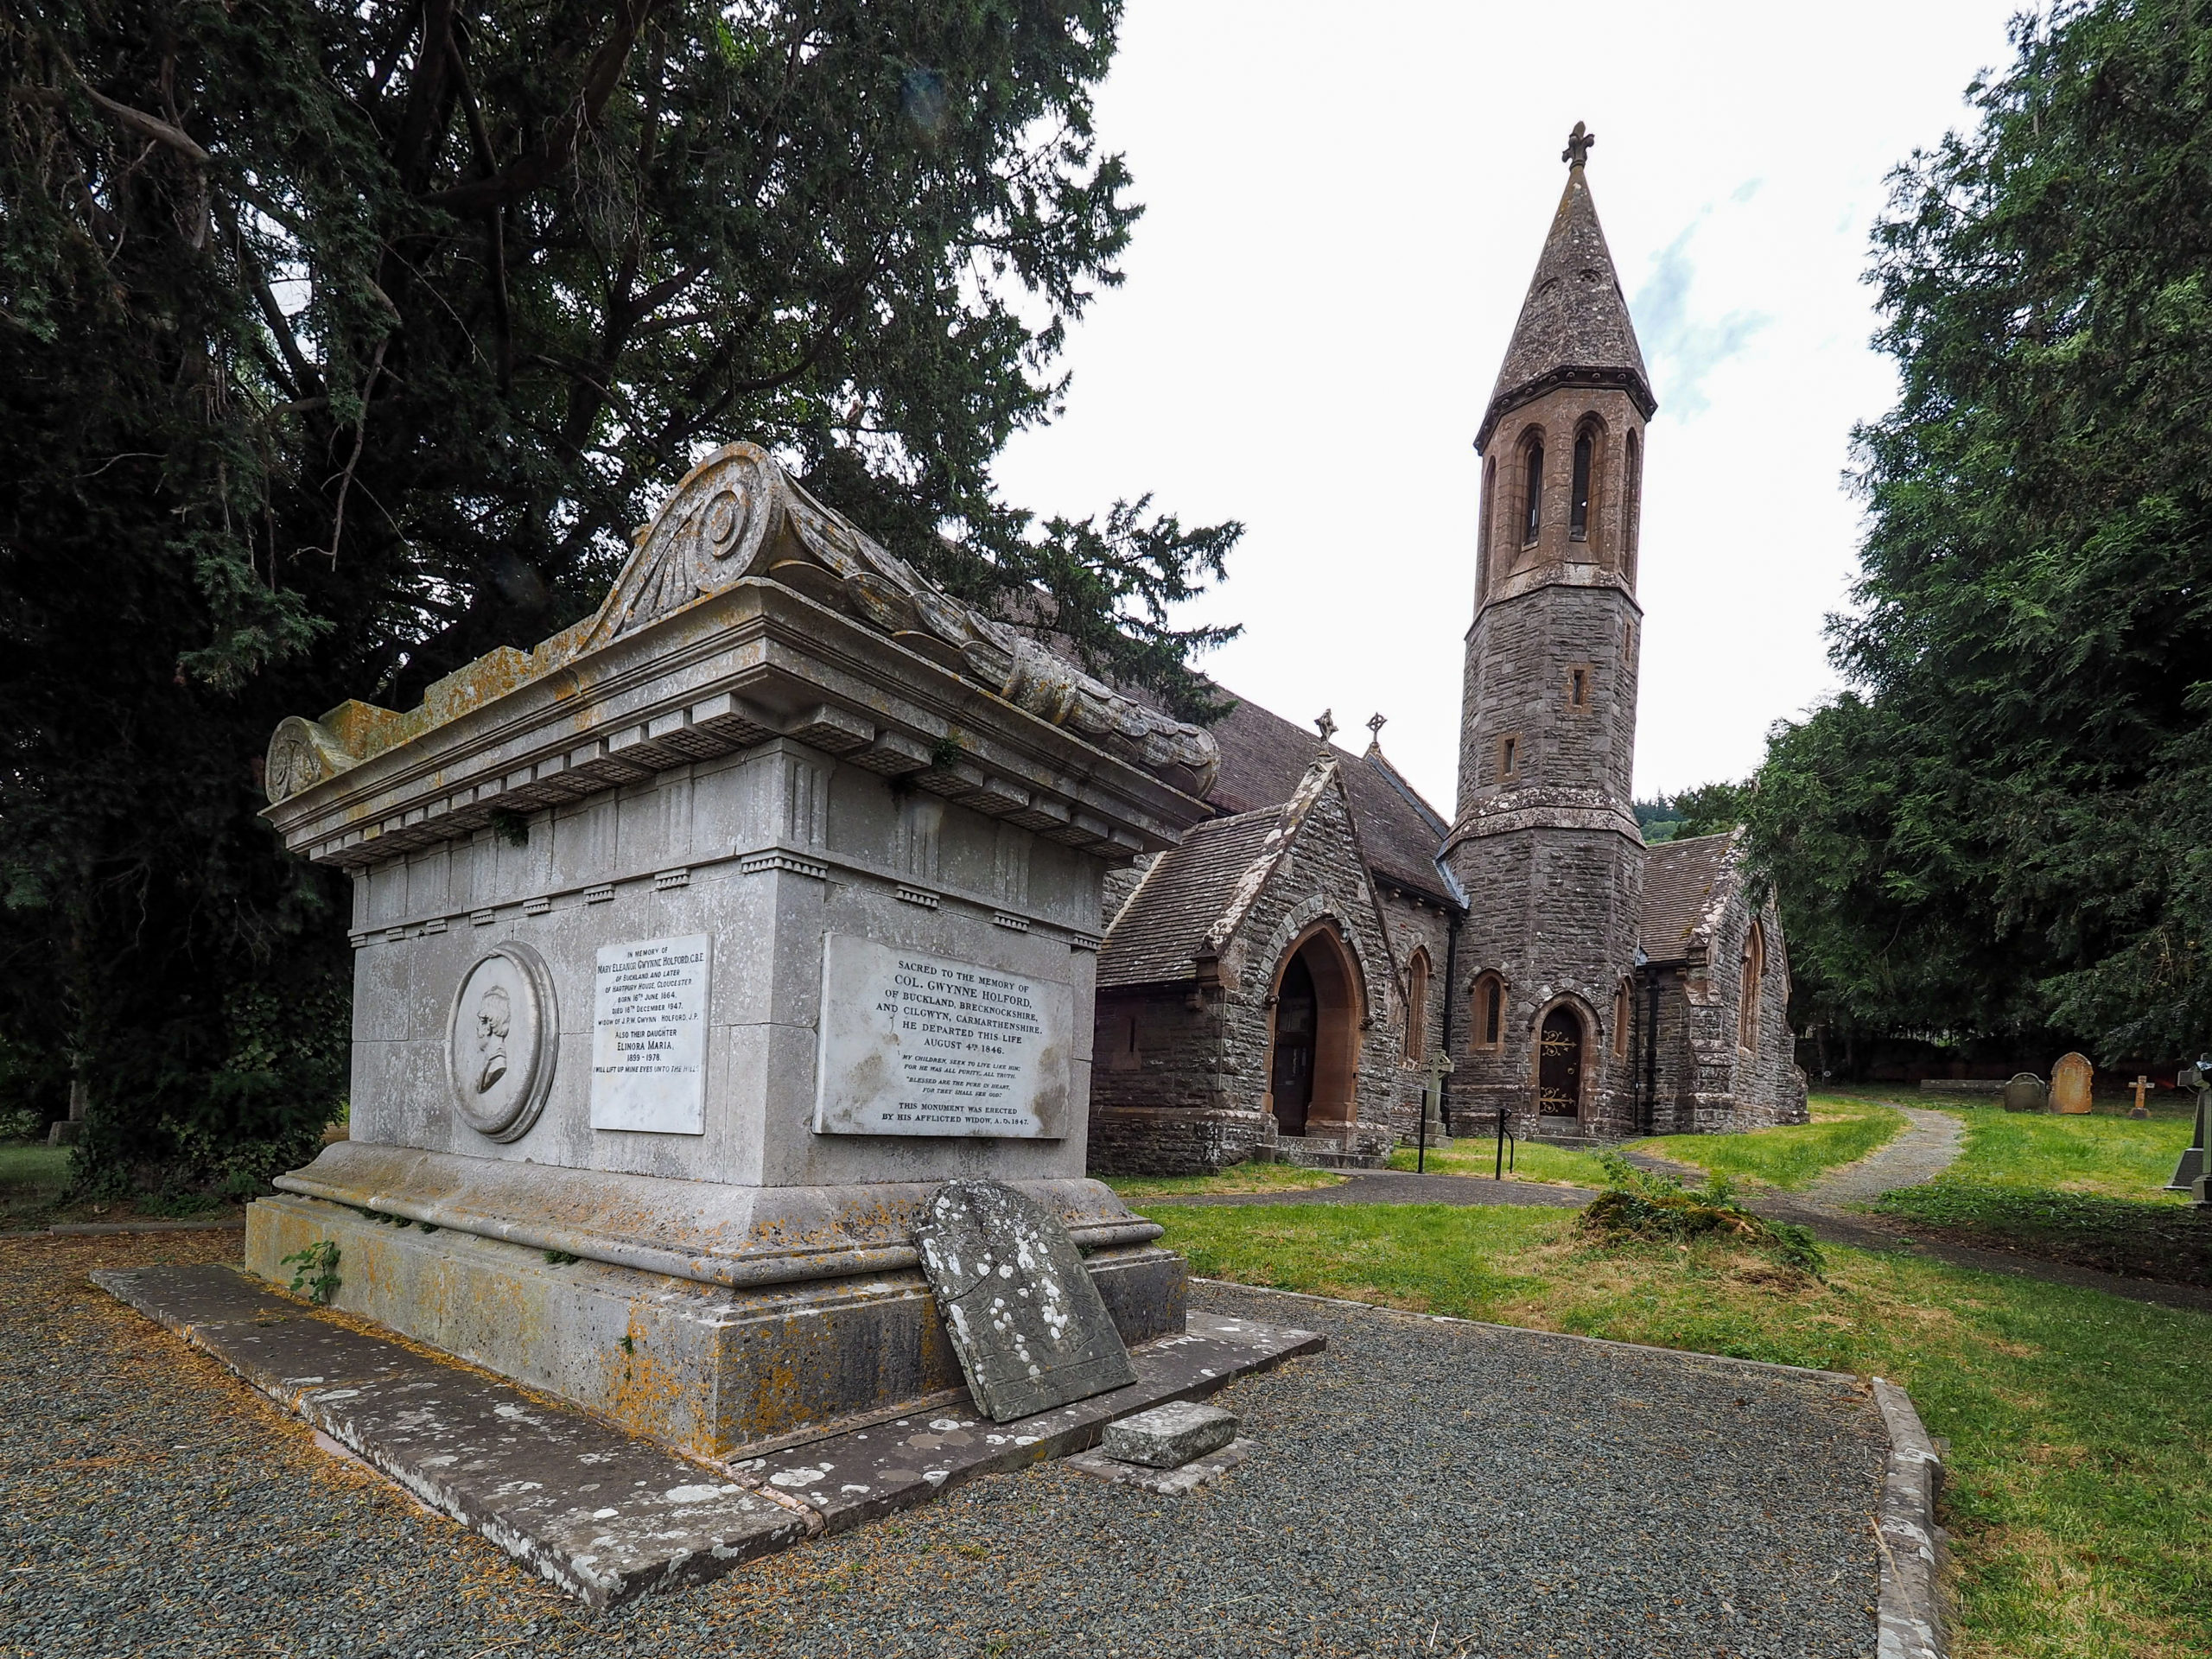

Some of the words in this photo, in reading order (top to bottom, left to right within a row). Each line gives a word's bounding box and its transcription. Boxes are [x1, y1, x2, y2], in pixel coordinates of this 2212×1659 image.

[635, 948, 659, 957] MEMORY
[597, 965, 612, 974] MARY
[613, 962, 637, 972] ELEANOR
[638, 958, 662, 969] GWYNNE
[663, 969, 681, 977] LATER
[898, 960, 938, 975] SACRED
[941, 969, 953, 978] TO
[957, 971, 975, 982] THE
[978, 976, 1015, 990] MEMORY
[1018, 984, 1029, 993] OF
[613, 984, 637, 993] HARTPURY
[894, 975, 924, 988] COL.
[927, 980, 977, 998] GWYNNE
[982, 990, 1032, 1009] HOLFORD,
[636, 1004, 665, 1013] DECEMBER
[885, 989, 899, 998] OF
[903, 992, 957, 1008] BUCKLAND,
[959, 1001, 1038, 1022] BRECKNOCKSHIRE,
[876, 1002, 899, 1013] AND
[903, 1007, 952, 1022] CILGWYN,
[956, 1014, 1042, 1034] CARMARTHENSHIRE.
[646, 1029, 677, 1038] DAUGHTER
[902, 1020, 917, 1030] HE
[922, 1023, 974, 1038] DEPARTED
[978, 1031, 999, 1041] THIS
[1002, 1034, 1022, 1044] LIFE
[617, 1042, 645, 1052] ELINORA
[924, 1039, 962, 1050] AUGUST
[982, 1045, 1004, 1054] 1846.
[921, 1103, 964, 1113] MONUMENT
[914, 1115, 962, 1123] AFFLICTED
[964, 1116, 992, 1125] WIDOW,
